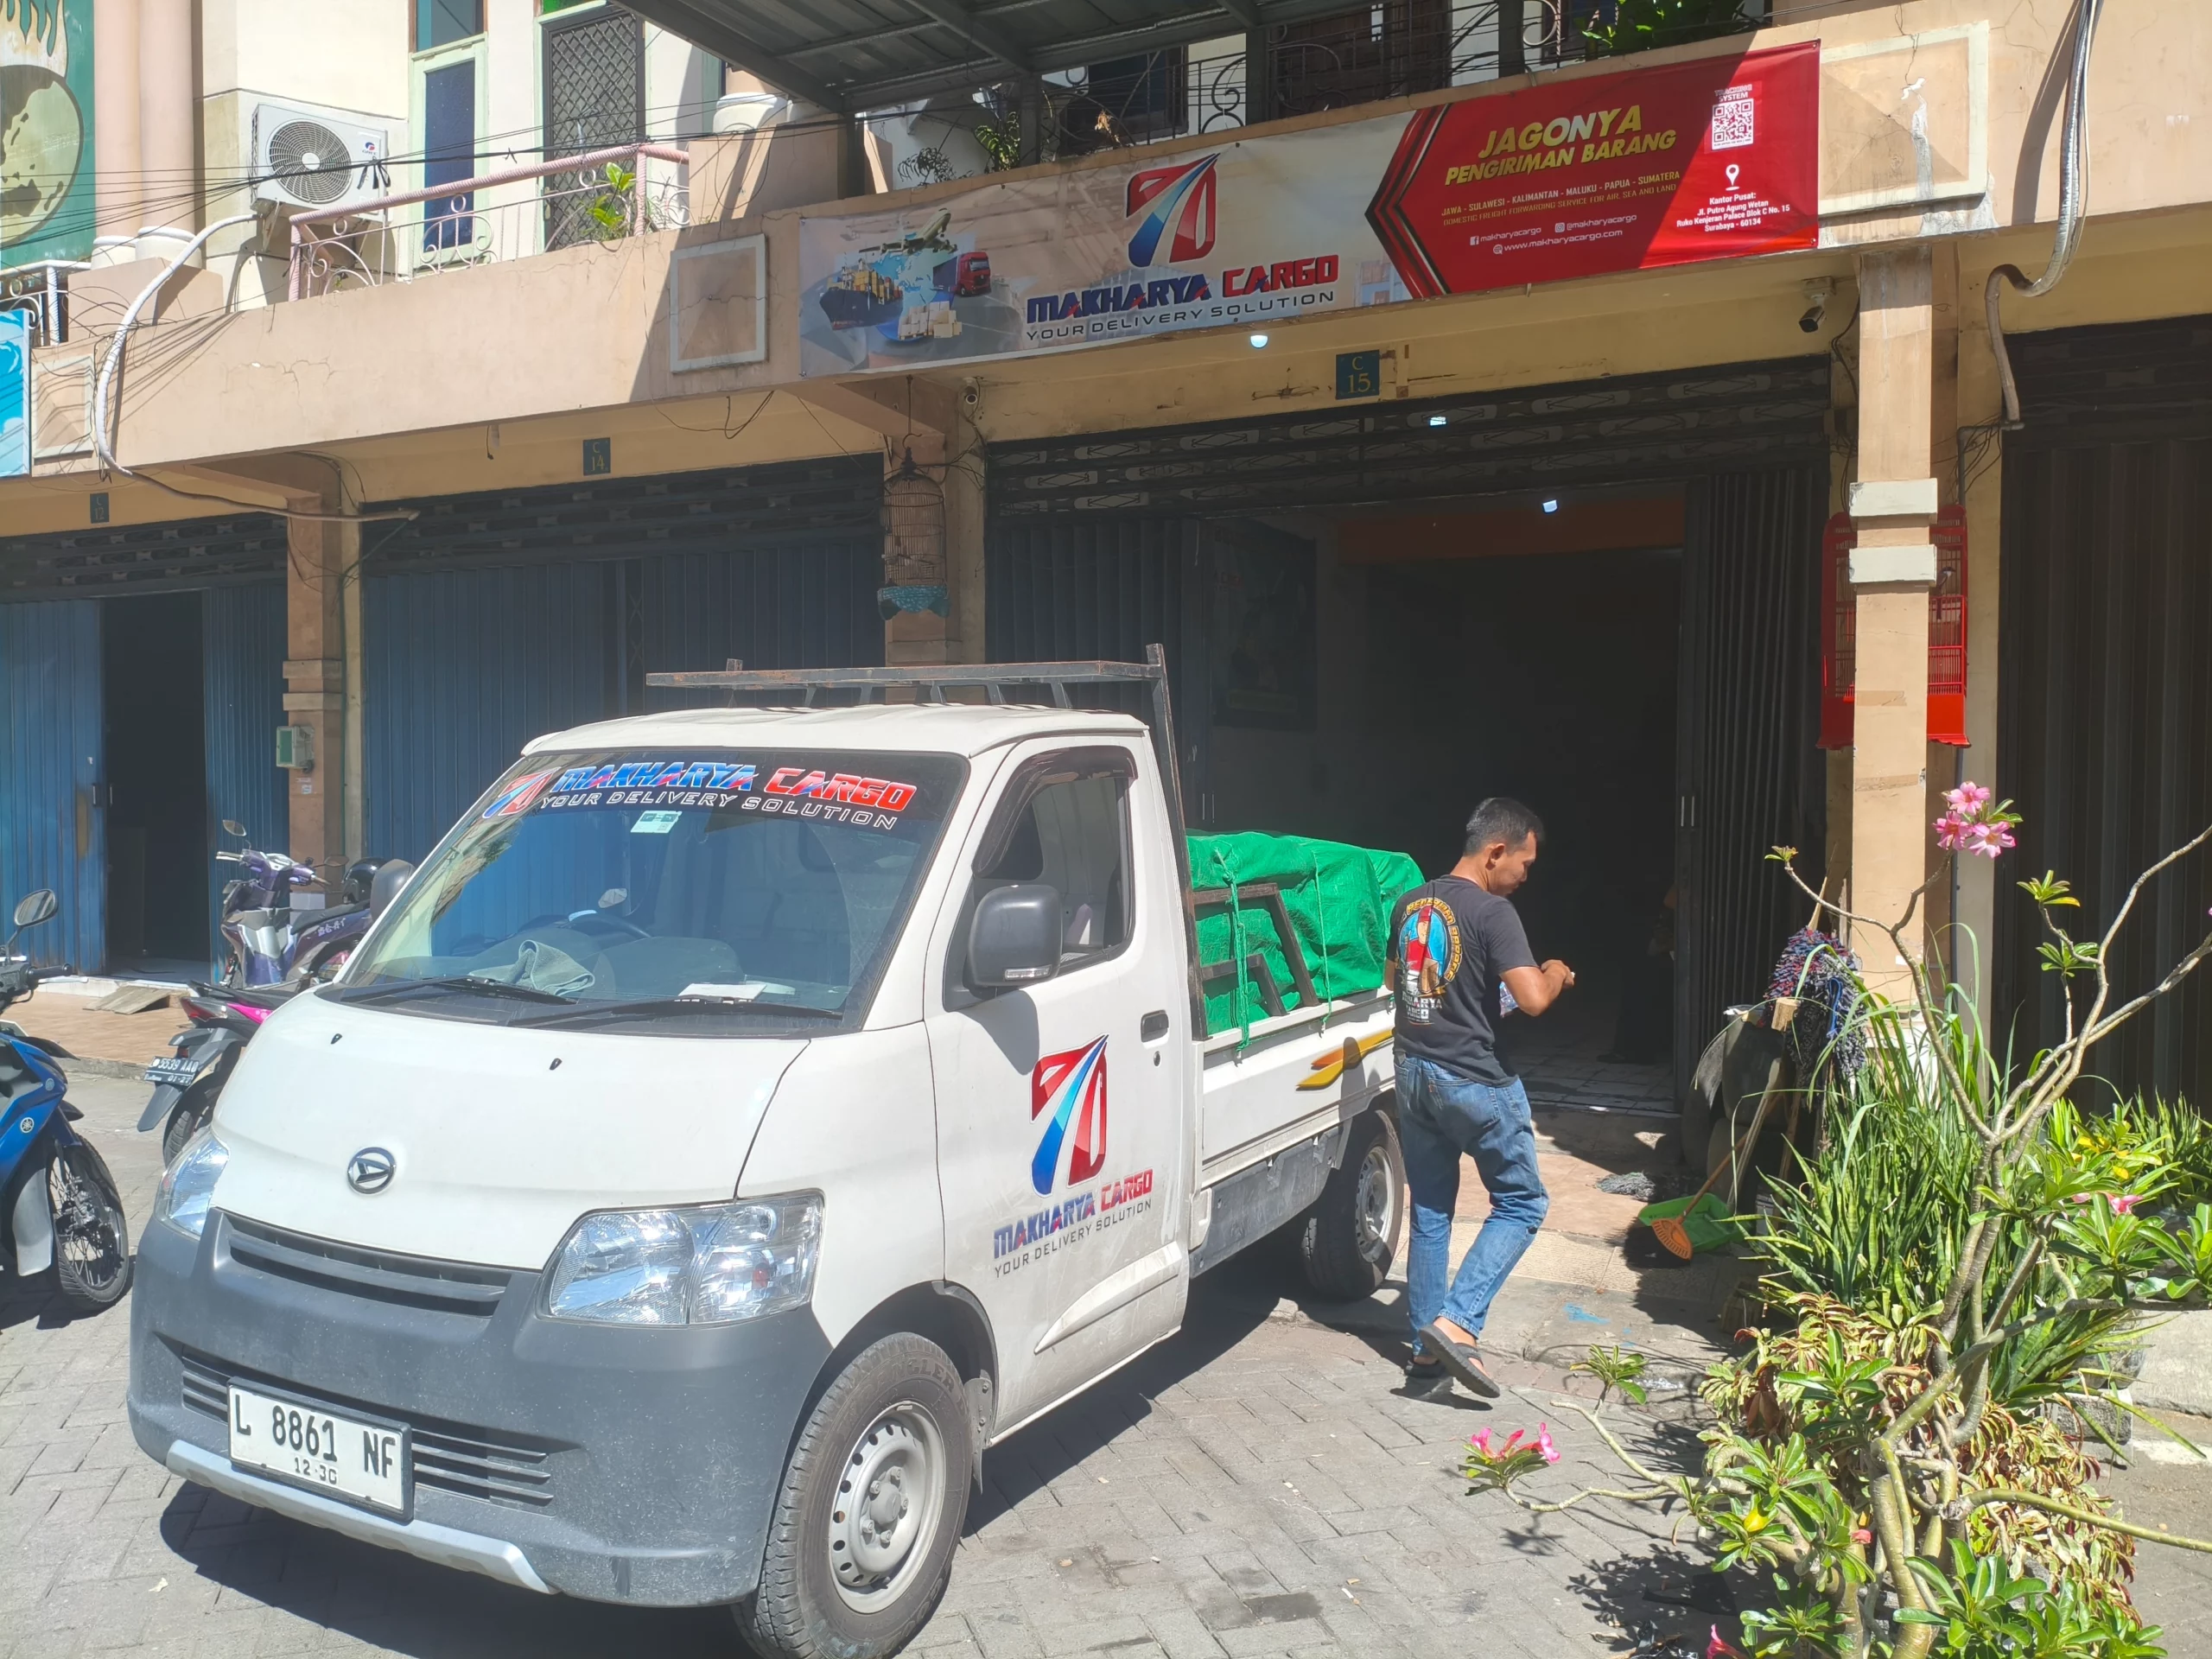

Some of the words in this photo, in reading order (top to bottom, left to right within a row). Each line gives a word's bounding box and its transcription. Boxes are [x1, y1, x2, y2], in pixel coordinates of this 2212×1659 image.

[1719, 92, 1748, 102] SYSTEM
[1478, 105, 1642, 159] JAGONYA
[1445, 147, 1575, 186] PENGIRIMAN
[1580, 130, 1676, 163] BARANG
[1441, 207, 1461, 216] JAWA
[1469, 198, 1505, 212] SULAWESI
[1512, 190, 1559, 204] KALIMANTAN
[1566, 184, 1598, 196] MALUKU
[1605, 179, 1630, 190] PAPUA
[1638, 171, 1681, 185] SUMATERA
[1733, 192, 1757, 202] Pusat:
[1443, 214, 1478, 226] DOMESTIC
[1479, 209, 1507, 219] FREIGHT
[1509, 202, 1556, 214] FORWARDING
[1557, 198, 1587, 207] SERVICE
[1590, 194, 1605, 203] FOR
[1623, 190, 1637, 199] SEA
[1639, 187, 1655, 195] AND
[1656, 183, 1676, 193] LAND
[1707, 207, 1725, 215] Putro
[1726, 203, 1746, 213] Agung
[1748, 200, 1769, 208] Wetan
[1567, 214, 1637, 231] @makharyacargo
[1676, 219, 1694, 227] Ruko
[1694, 215, 1722, 225] Kenjeran
[1723, 211, 1745, 220] Palace
[1746, 208, 1761, 217] Blok
[1705, 222, 1734, 232] Surabaya
[1740, 218, 1761, 227] 60134
[1480, 227, 1541, 242] makharyacargo
[1504, 230, 1623, 251] www.makharyacargo.com
[1027, 273, 1212, 324] MAKHARYA
[1223, 255, 1339, 298] CARGO
[1027, 325, 1084, 340] YOUR
[1092, 308, 1204, 334] DELIVERY
[1211, 291, 1334, 318] SOLUTION
[1352, 356, 1363, 371] C
[1348, 372, 1371, 393] 15
[591, 454, 605, 472] 14
[550, 762, 760, 793] MAKHARYA
[764, 767, 918, 811] CARGO
[541, 792, 602, 809] YOUR
[606, 790, 738, 807] DELIVERY
[741, 797, 898, 830] SOLUTION
[158, 1058, 181, 1071] 5539
[994, 1192, 1096, 1259] MAKHARYA
[1101, 1168, 1154, 1212] CARGO
[995, 1253, 1029, 1278] YOUR
[1034, 1224, 1092, 1260] DELIVERY
[1096, 1198, 1151, 1231] SOLUTION
[235, 1394, 251, 1436] L
[272, 1405, 338, 1463] 8861
[363, 1430, 396, 1478] NF
